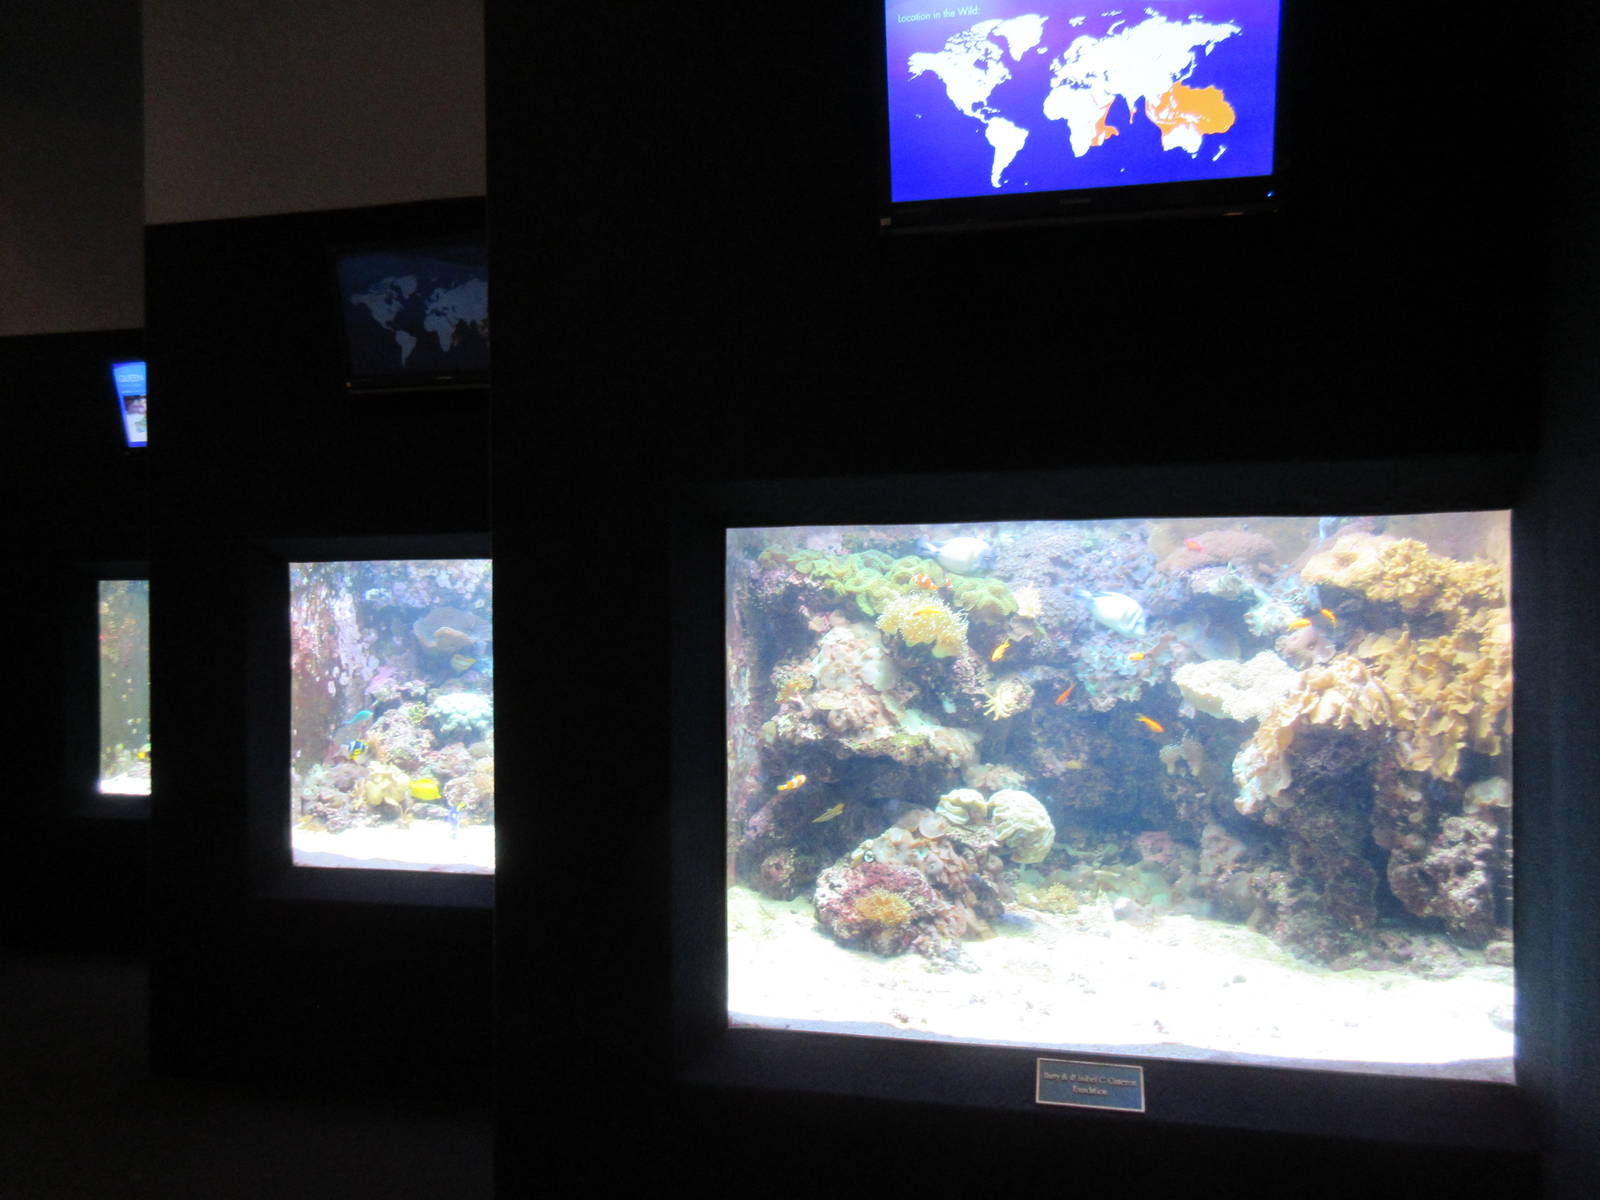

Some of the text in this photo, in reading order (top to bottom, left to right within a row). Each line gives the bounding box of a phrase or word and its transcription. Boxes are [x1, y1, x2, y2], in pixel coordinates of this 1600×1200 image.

[897, 13, 931, 23] Location
[933, 11, 941, 20] in
[943, 8, 956, 18] the
